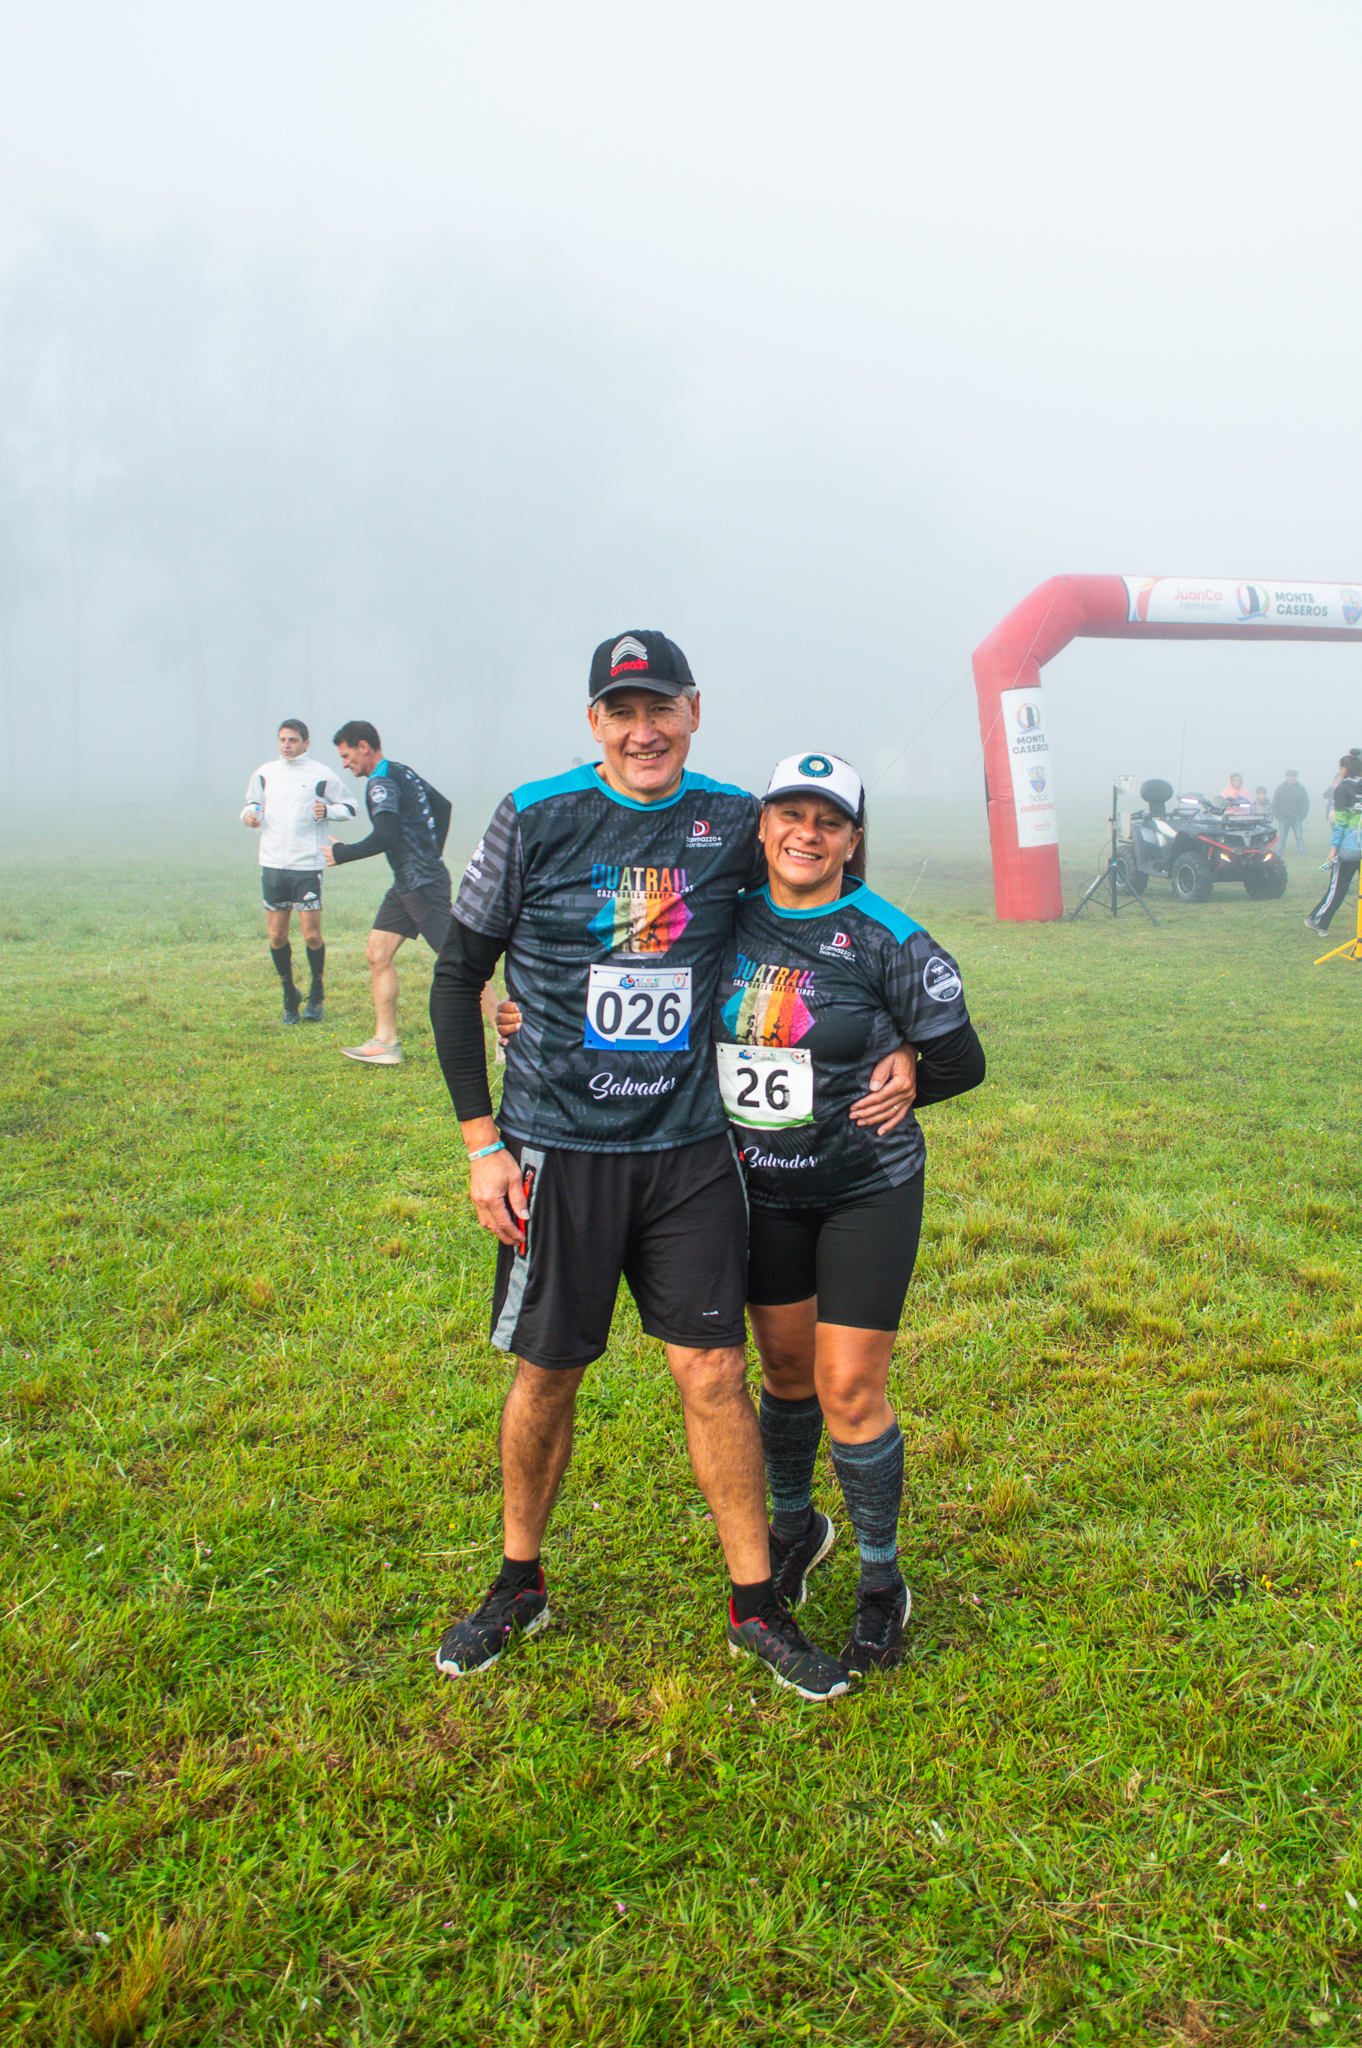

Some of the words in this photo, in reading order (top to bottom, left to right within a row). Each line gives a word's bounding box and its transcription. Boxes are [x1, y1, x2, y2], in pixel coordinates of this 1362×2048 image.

[1174, 588, 1222, 601] JuanCa
[1275, 591, 1315, 603] MONTE
[1277, 603, 1328, 617] CASEROS
[1013, 743, 1049, 754] CASEROS
[1017, 734, 1045, 745] MONTE
[732, 953, 815, 989] DUATRAIL
[595, 991, 681, 1036] 026
[588, 1072, 676, 1100] Salvador
[737, 1067, 791, 1111] 26
[743, 1146, 818, 1168] Salvador
